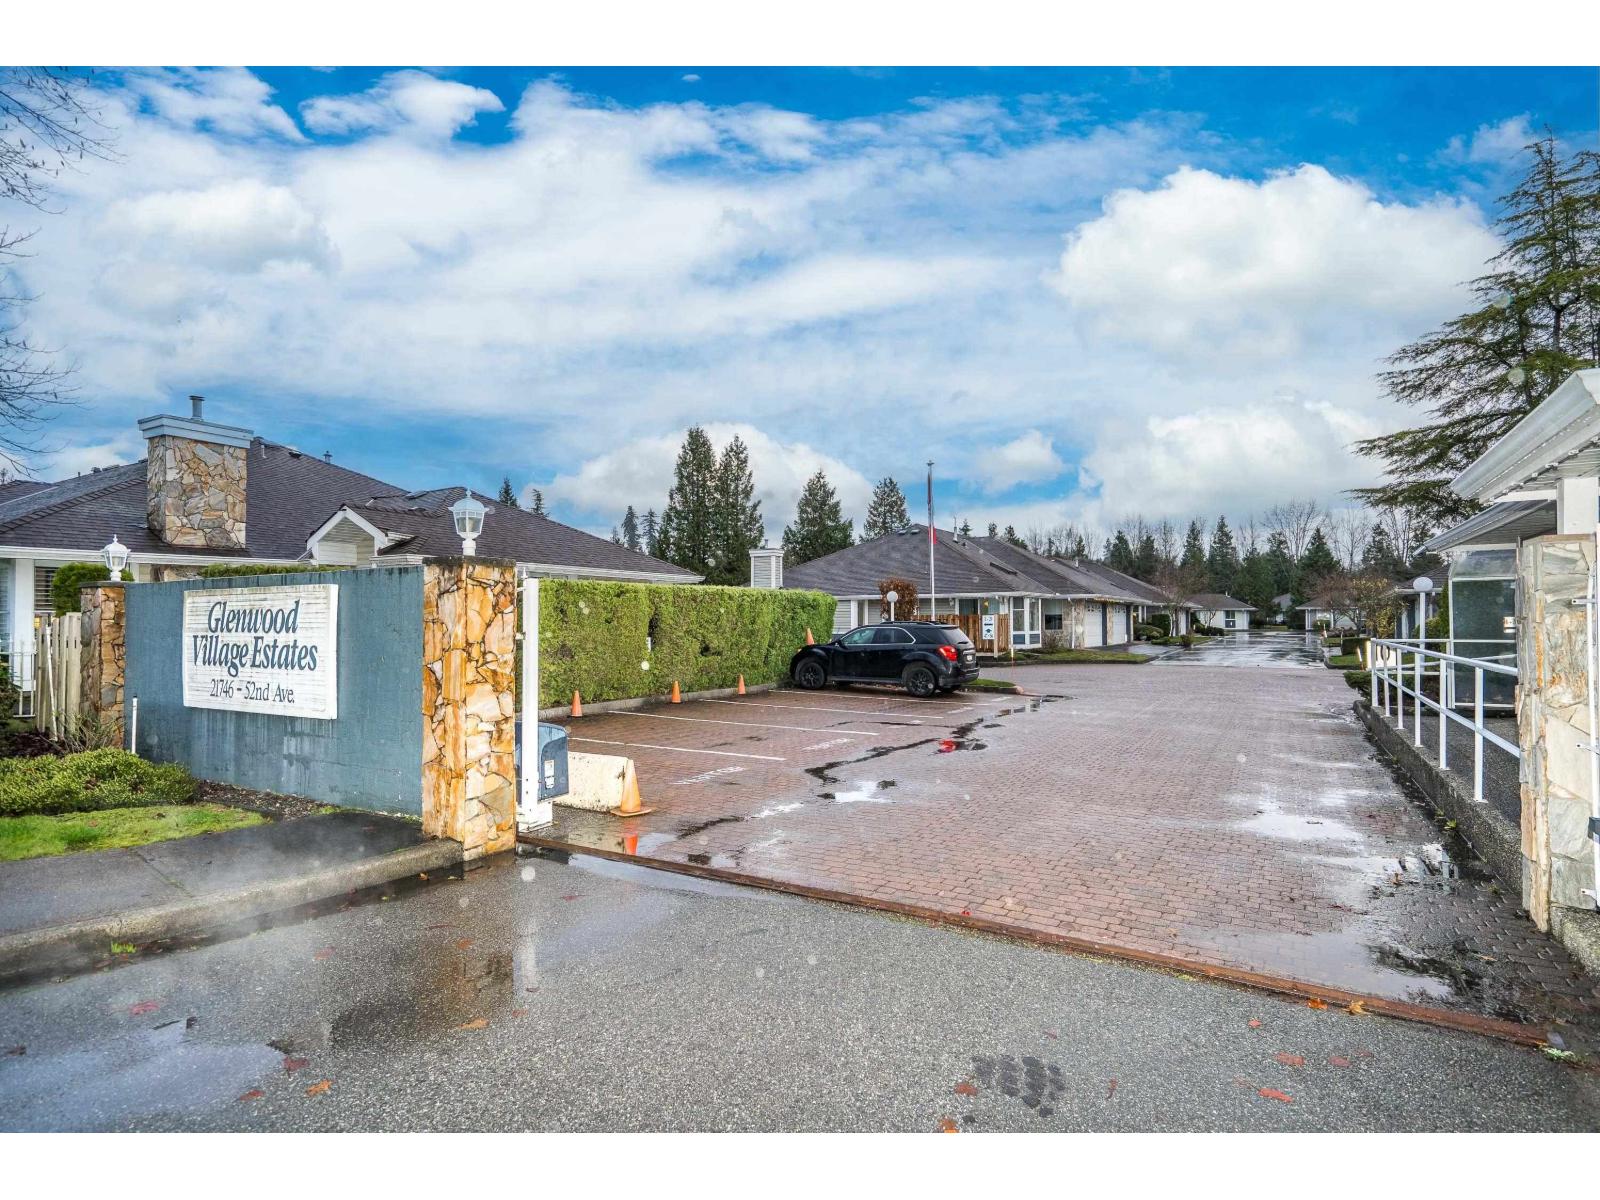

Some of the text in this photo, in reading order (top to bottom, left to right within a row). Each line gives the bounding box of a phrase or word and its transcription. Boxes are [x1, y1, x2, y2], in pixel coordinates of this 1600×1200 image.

[208, 600, 300, 633] Glenwood
[193, 635, 317, 677] Village Estates
[210, 679, 234, 698] 21746
[244, 681, 269, 701] 52nd
[273, 684, 295, 703] Ave.
